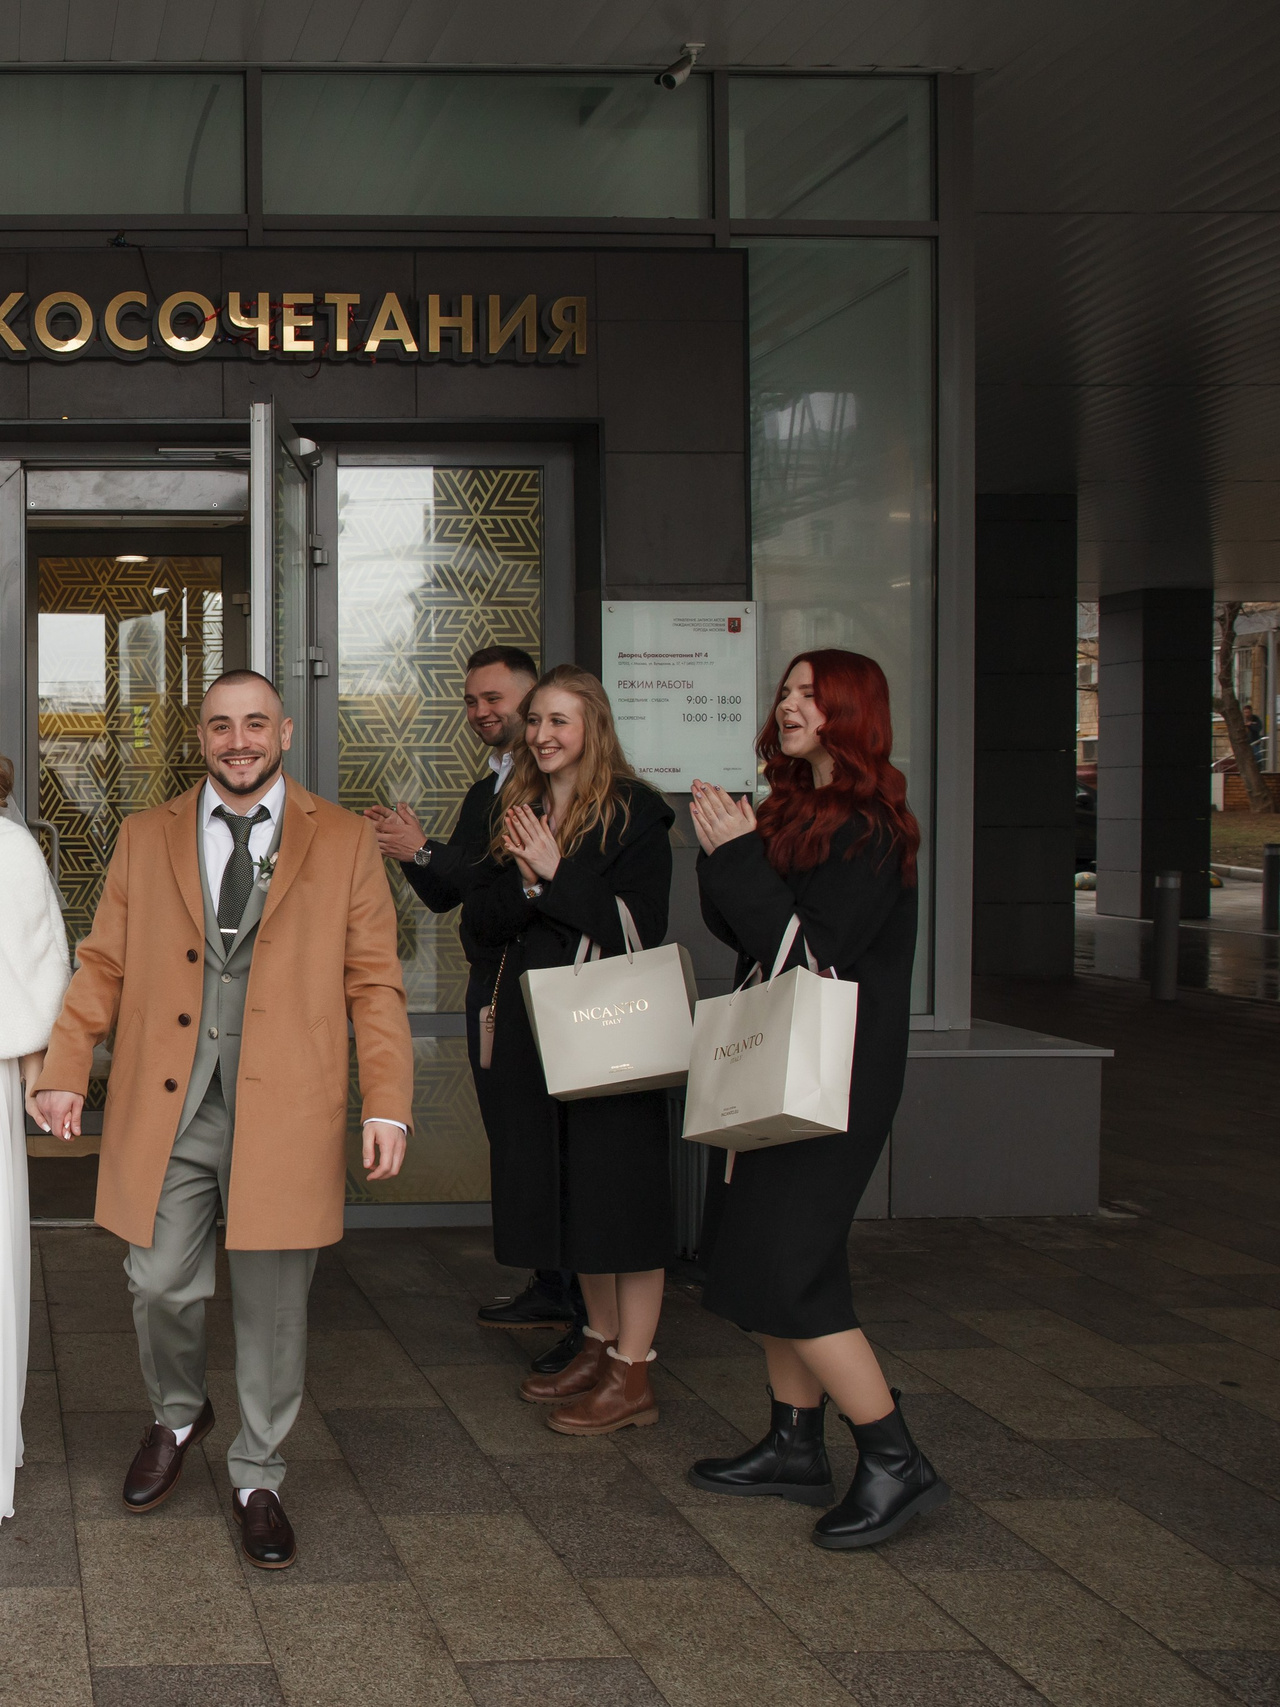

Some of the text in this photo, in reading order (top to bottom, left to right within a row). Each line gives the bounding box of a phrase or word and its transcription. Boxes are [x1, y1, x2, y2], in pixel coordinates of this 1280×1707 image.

[643, 651, 693, 659] бракосочетания
[617, 680, 694, 689] РЕЖИМ РАБОТЫ
[686, 695, 708, 705] 9:00
[717, 695, 742, 705] 18:00
[682, 713, 708, 722] 10:00
[717, 713, 742, 722] 19:00
[572, 998, 649, 1024] INCANTO
[602, 1017, 622, 1027] ITALY
[714, 1032, 764, 1061] INCANTO
